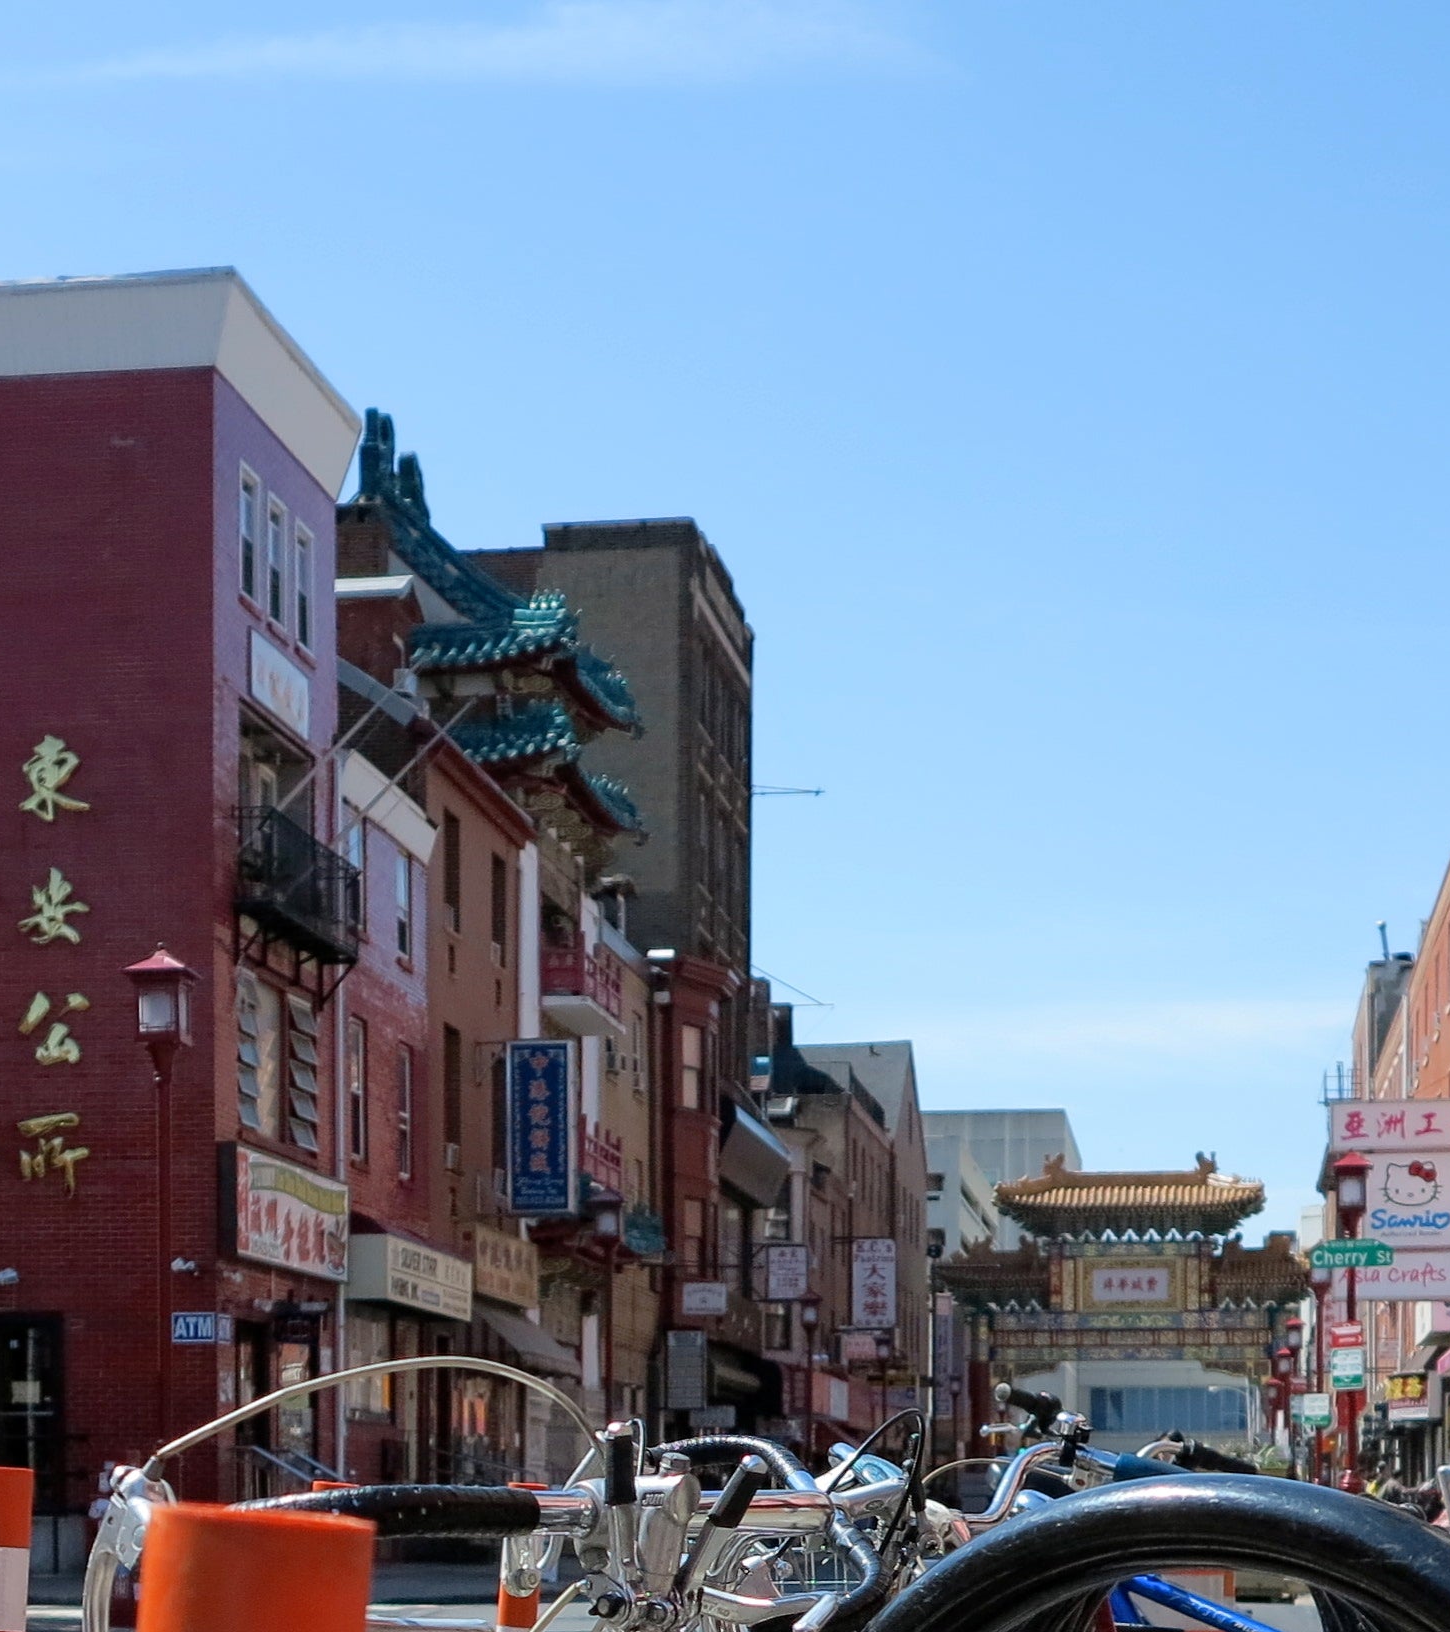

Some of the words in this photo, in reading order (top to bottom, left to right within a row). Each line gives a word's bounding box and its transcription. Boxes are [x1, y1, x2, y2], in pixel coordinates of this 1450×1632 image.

[18, 733, 92, 1198] 東安公所
[1312, 1250, 1368, 1267] Cherry
[1376, 1249, 1392, 1263] St
[1388, 1262, 1447, 1287] Crafts
[174, 1315, 213, 1339] ATM
